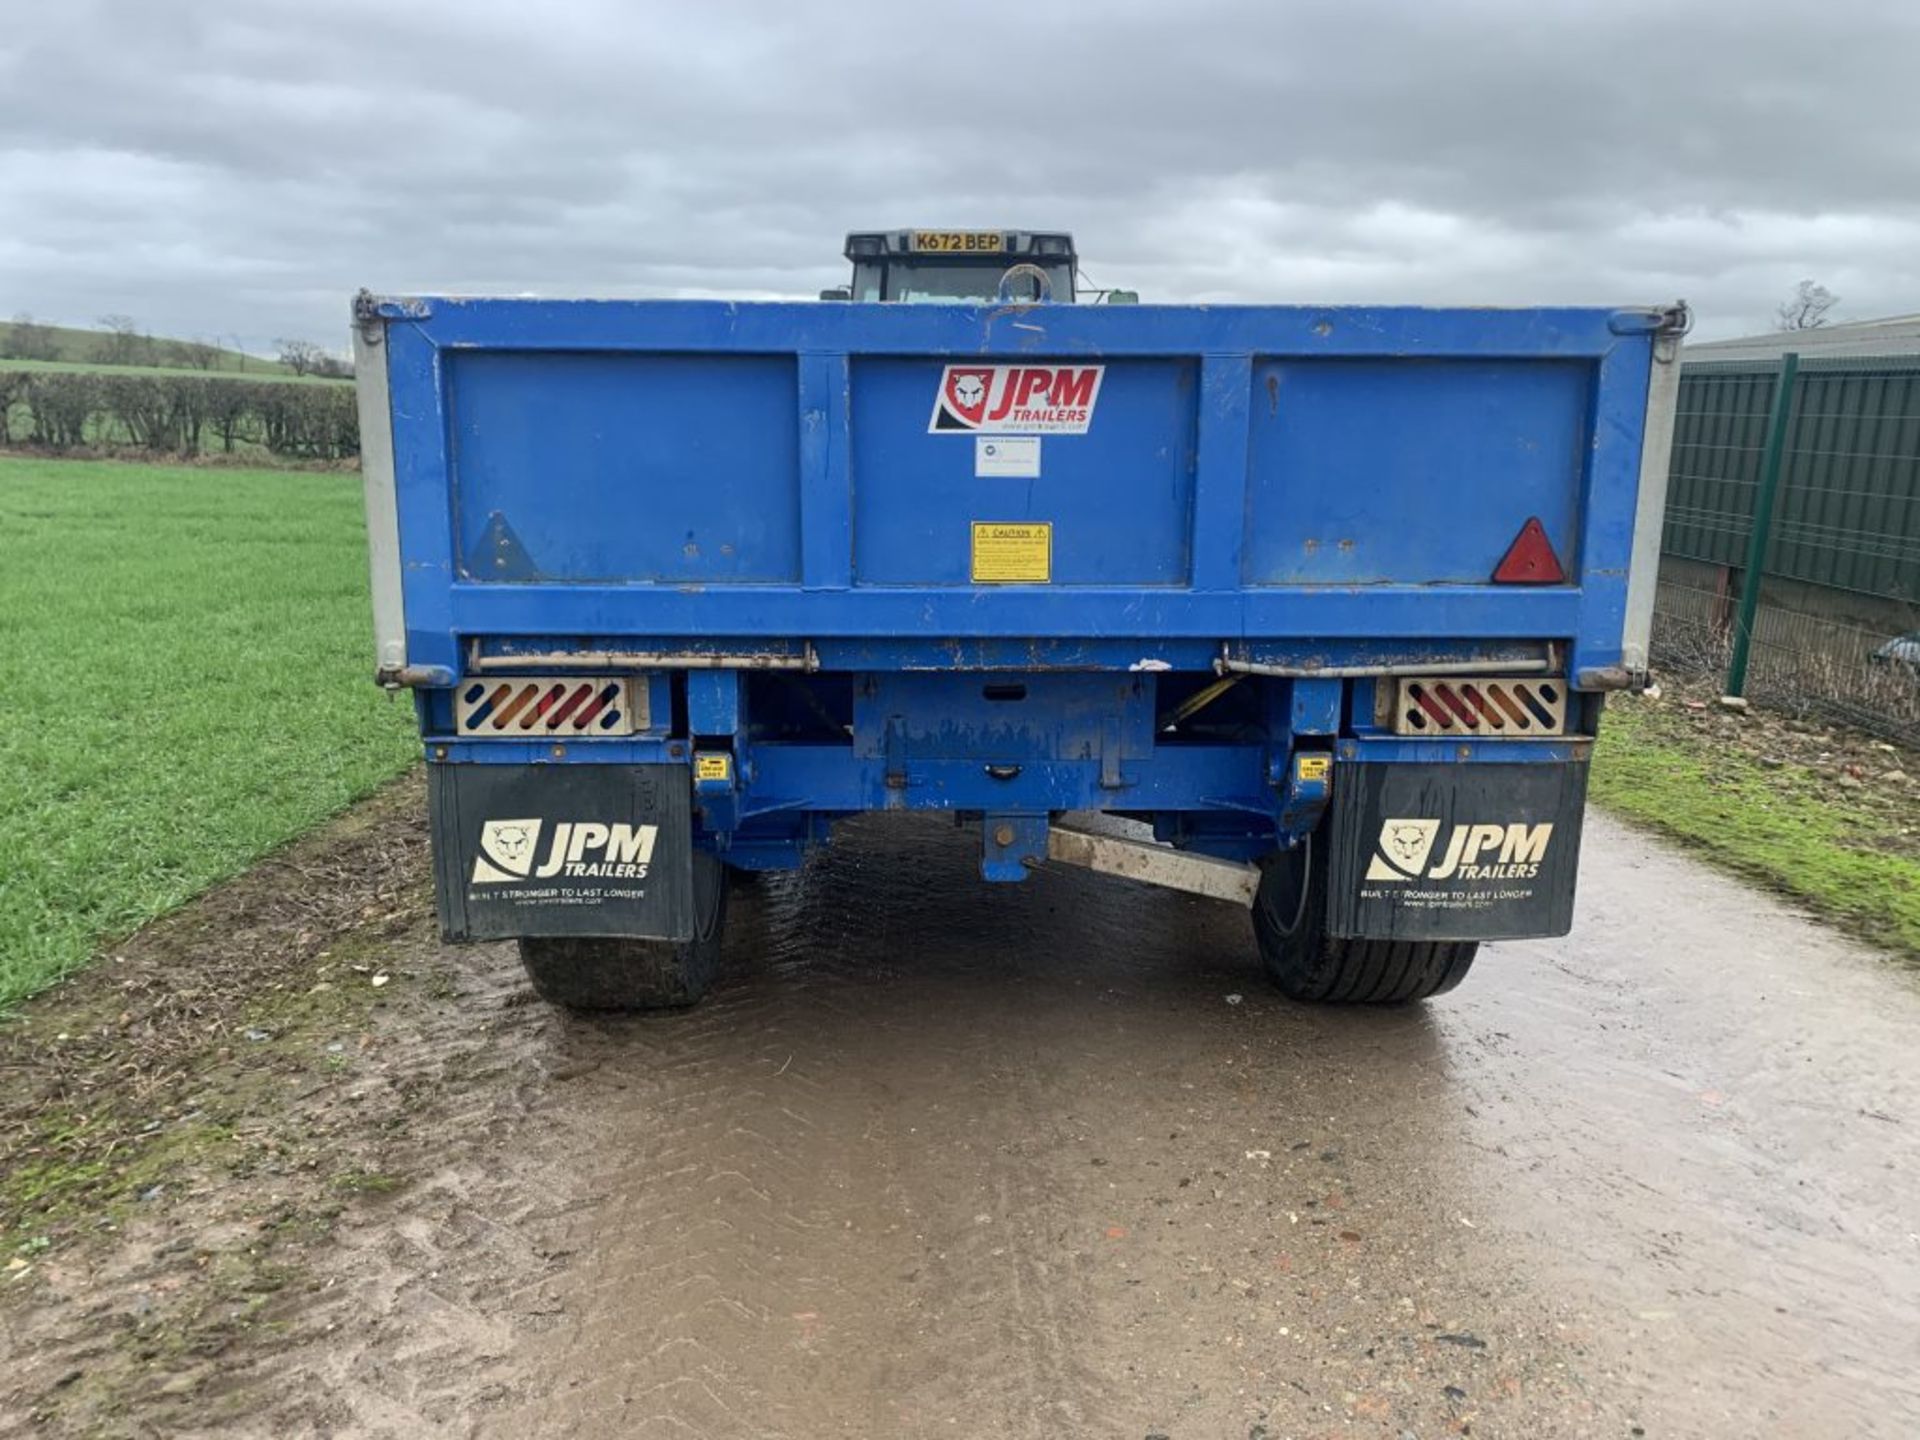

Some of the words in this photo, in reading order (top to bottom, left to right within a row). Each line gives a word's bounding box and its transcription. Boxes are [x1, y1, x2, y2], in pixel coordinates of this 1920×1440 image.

[916, 233, 961, 250] K672
[965, 233, 1000, 250] BEP
[988, 368, 1098, 421] JPM
[1013, 409, 1087, 422] TRAILERS
[535, 822, 659, 878] JPM
[1427, 822, 1554, 880] JPM
[564, 863, 649, 879] TRAILERS
[1457, 863, 1539, 880] TRAILERS
[502, 888, 558, 899] STRONGER
[561, 888, 575, 898] TO
[576, 888, 603, 898] LAST
[604, 889, 645, 899] LONGER
[1452, 891, 1465, 901] TO
[1466, 891, 1492, 901] LAST
